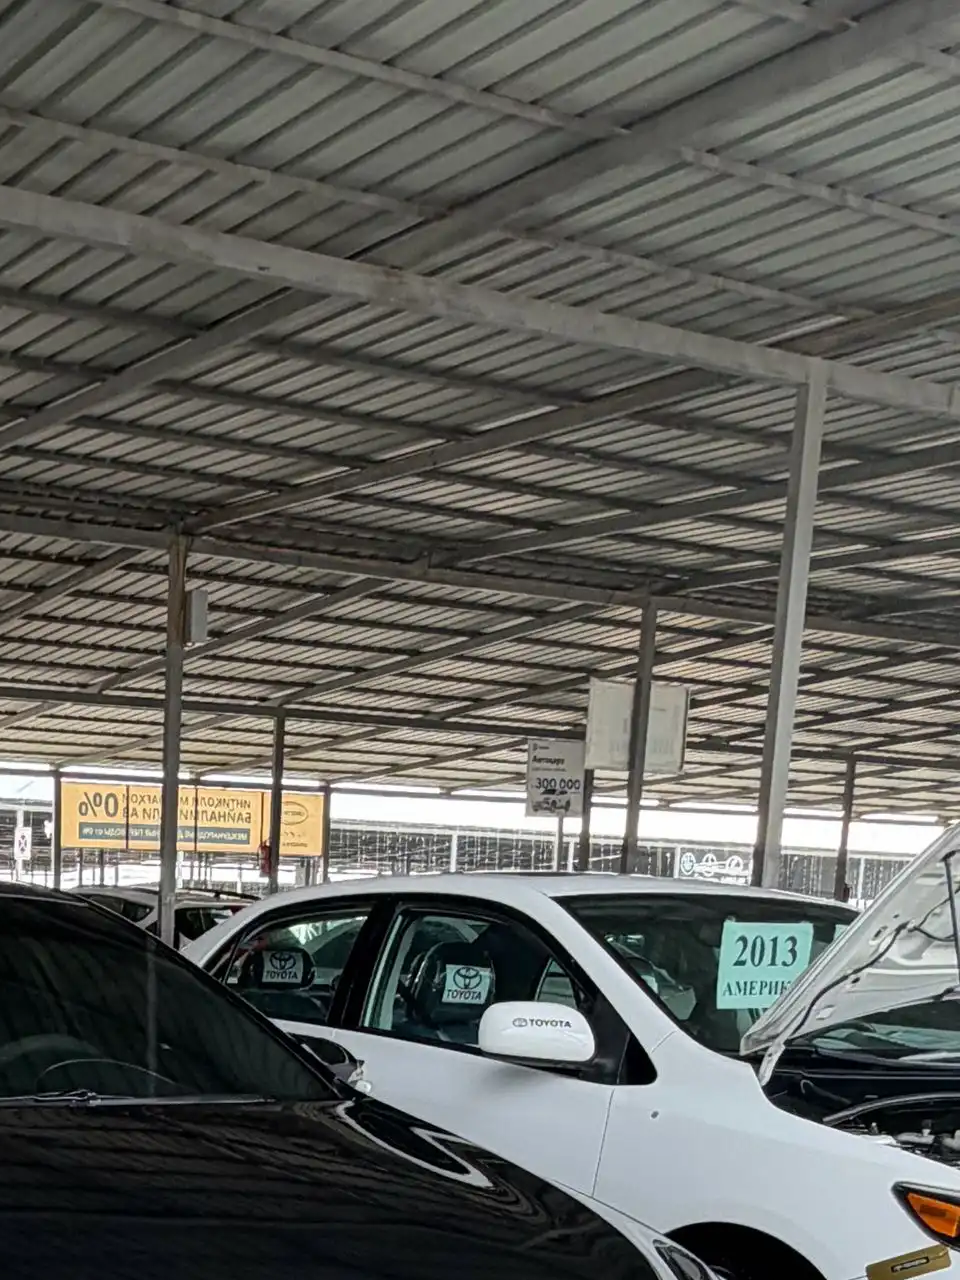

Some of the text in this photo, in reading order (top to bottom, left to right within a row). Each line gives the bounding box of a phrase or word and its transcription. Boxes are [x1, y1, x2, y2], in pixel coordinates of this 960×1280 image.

[732, 934, 798, 968] 2013
[265, 970, 298, 980] TOYOTA
[446, 988, 482, 1001] TOYOTA
[528, 1017, 572, 1029] TOYOTA
